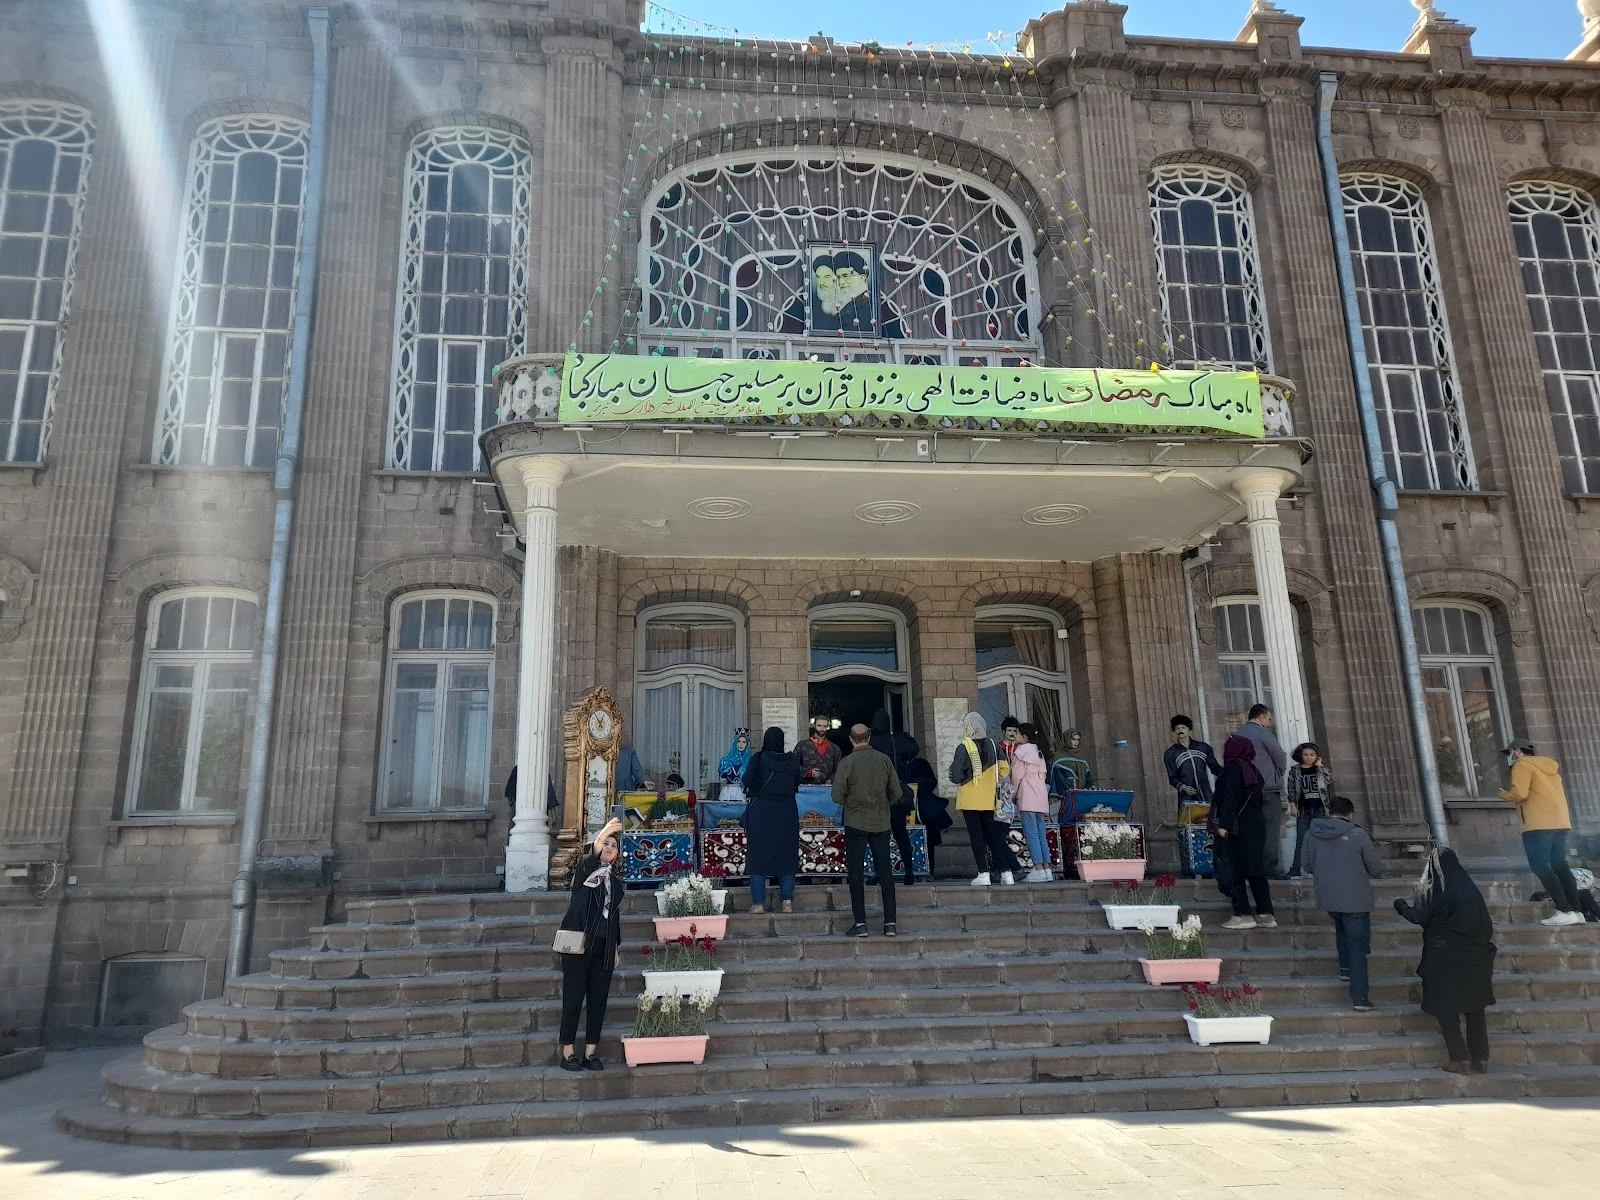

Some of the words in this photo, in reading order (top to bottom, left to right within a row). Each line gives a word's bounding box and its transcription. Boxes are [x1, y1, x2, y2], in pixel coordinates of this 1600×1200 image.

[628, 364, 735, 400] جهان
[716, 370, 784, 404] مسلمین
[777, 381, 796, 407] بر
[797, 367, 854, 409] قرآن
[845, 372, 898, 408] نزول
[906, 371, 956, 412] الهی
[952, 374, 1026, 410] ضیافت
[1030, 379, 1054, 402] ماه
[1058, 369, 1171, 408] رمضان
[1167, 371, 1232, 420] مبارک
[1236, 390, 1253, 414] ماه
